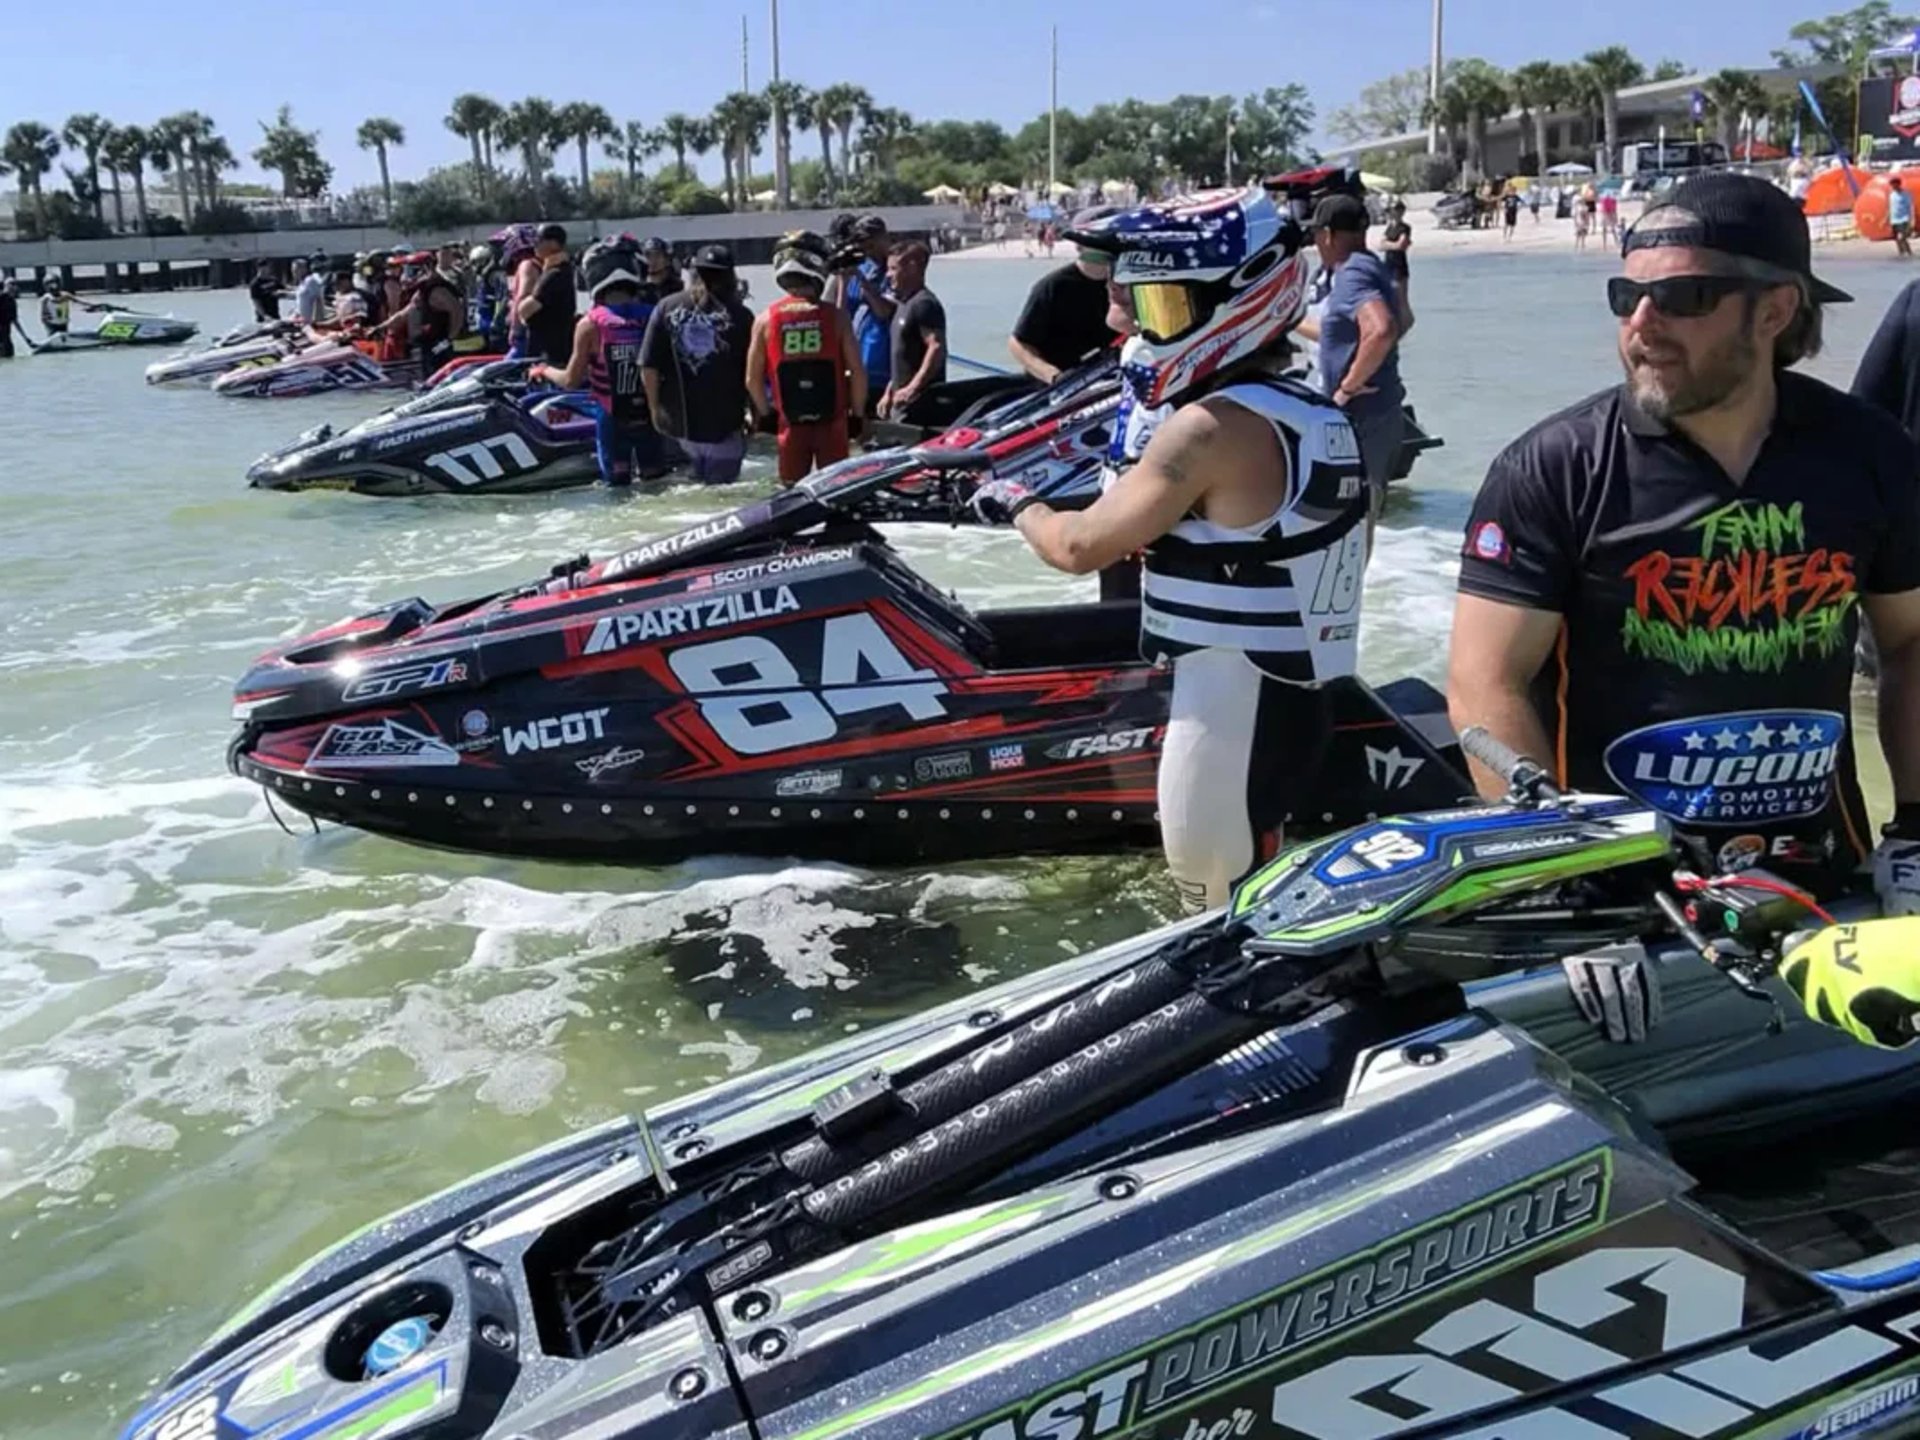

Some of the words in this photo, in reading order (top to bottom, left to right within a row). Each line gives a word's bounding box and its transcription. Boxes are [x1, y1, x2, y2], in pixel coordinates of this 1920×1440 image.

[784, 329, 821, 354] 88
[424, 432, 540, 486] 177
[623, 514, 743, 568] PARTZILLA
[1682, 499, 1804, 561] TEAM
[713, 562, 763, 586] SCOTT
[767, 548, 853, 574] CHAMPION
[1623, 548, 1856, 633] RECKLESS
[617, 585, 800, 645] PARTZILLA
[668, 611, 950, 755] 84
[502, 707, 610, 756] WCOT
[990, 744, 1022, 758] LIQUI
[1068, 727, 1156, 758] FAST
[990, 756, 1025, 770] MOLY
[1683, 799, 1814, 818] SERVICES
[1145, 1163, 1603, 1406] POWERSPORTS
